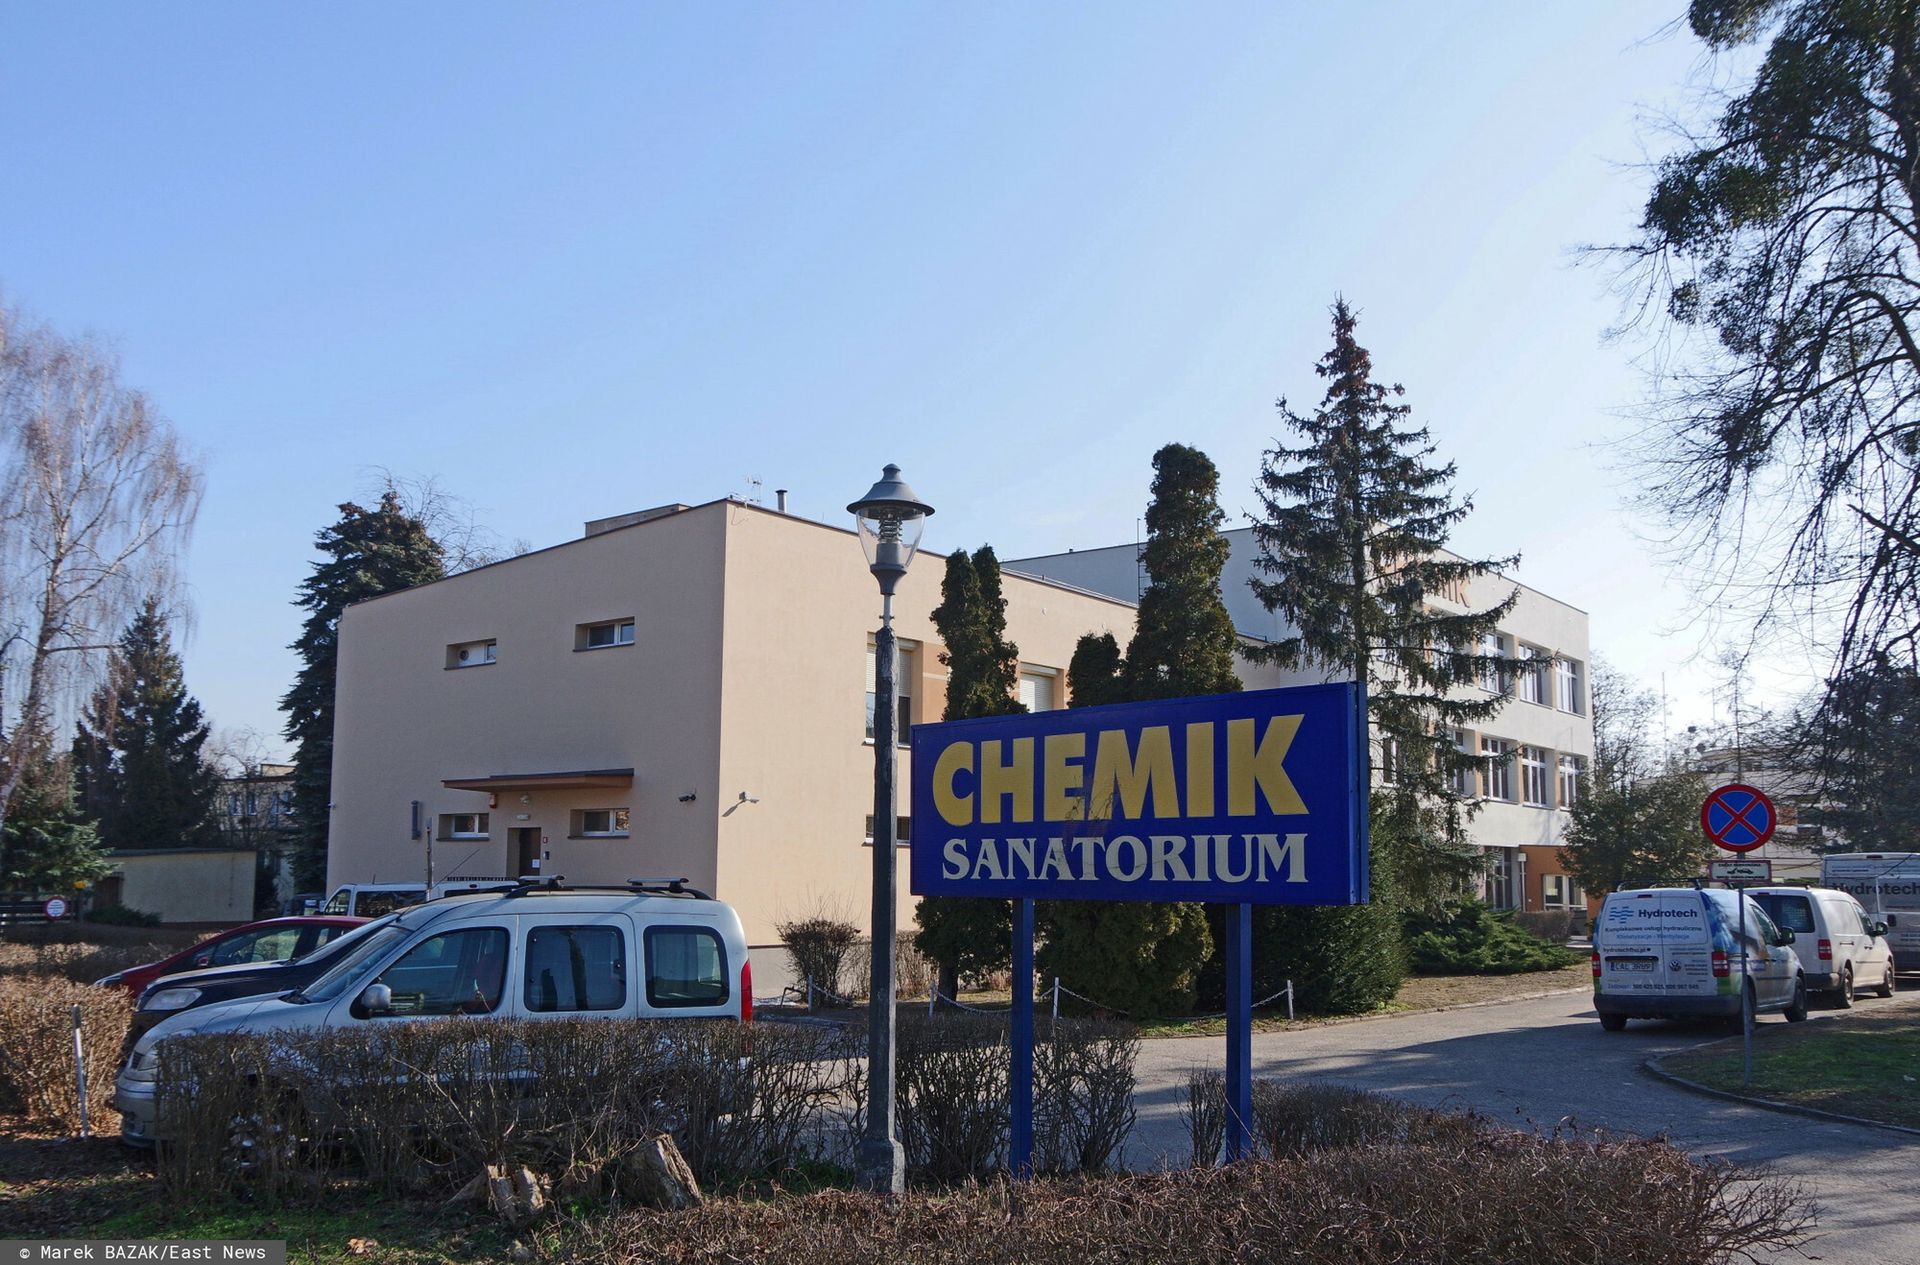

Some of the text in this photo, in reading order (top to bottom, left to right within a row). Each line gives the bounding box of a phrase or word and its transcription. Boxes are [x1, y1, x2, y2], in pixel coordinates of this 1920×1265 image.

[932, 713, 1310, 827] CHEMIK
[942, 833, 1309, 883] SANATORIUM
[1638, 909, 1697, 919] Hydrotech
